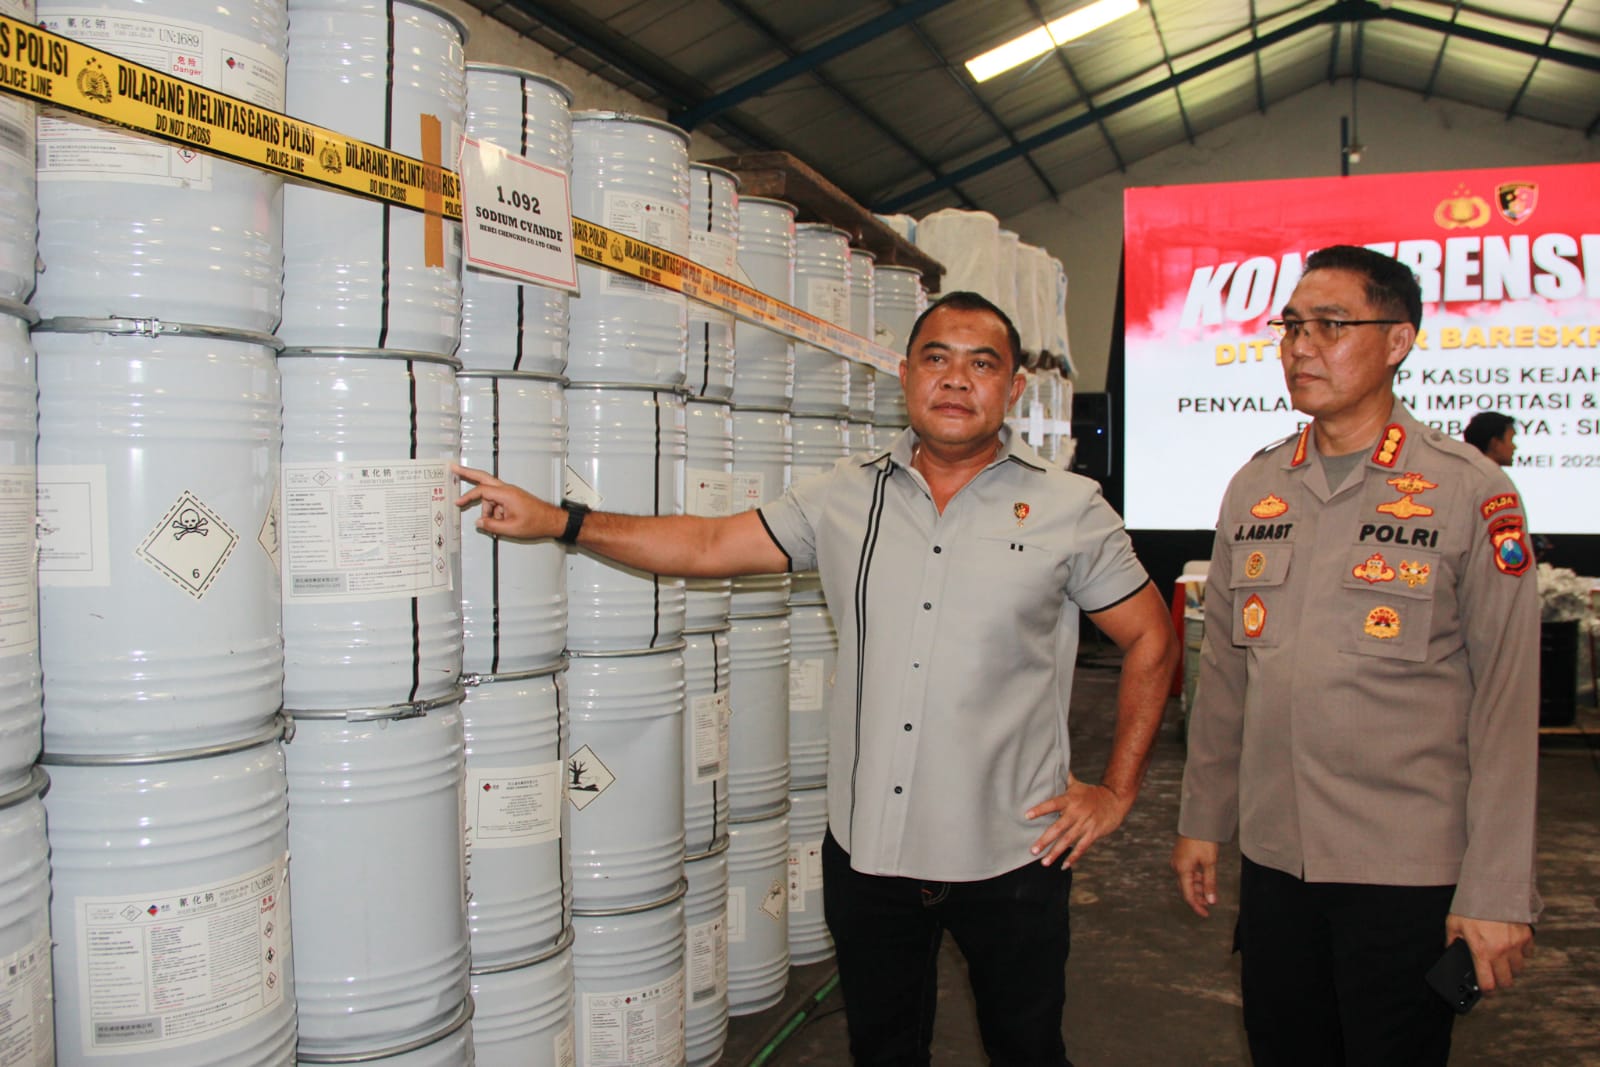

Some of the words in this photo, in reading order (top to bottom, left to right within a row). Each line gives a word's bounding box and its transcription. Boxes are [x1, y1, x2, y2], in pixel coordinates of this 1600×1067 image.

[159, 29, 200, 48] UN:1689
[16, 27, 68, 77] POLISI
[173, 64, 202, 76] Danger
[31, 73, 52, 97] LINE
[118, 65, 185, 115] DILARANG
[282, 121, 315, 156] POLISI
[156, 113, 167, 132] DO
[169, 118, 185, 137] NOT
[186, 123, 211, 145] CROSS
[266, 147, 289, 168] POLICE
[291, 155, 305, 172] LINE
[345, 142, 389, 179] DILARANG
[370, 179, 378, 194] DO
[379, 181, 389, 196] NOT
[390, 184, 407, 202] CROSS
[497, 185, 541, 215] 1.092
[475, 206, 518, 229] SODIUM
[520, 219, 563, 242] CYANIDE
[1422, 368, 1510, 385] KASUS
[1428, 393, 1571, 410] IMPORTASI
[1581, 393, 1596, 409] &
[1517, 455, 1553, 467] MEI
[1234, 524, 1293, 541] J.ABAST
[1359, 524, 1438, 548] POLRI
[192, 568, 200, 579] 6
